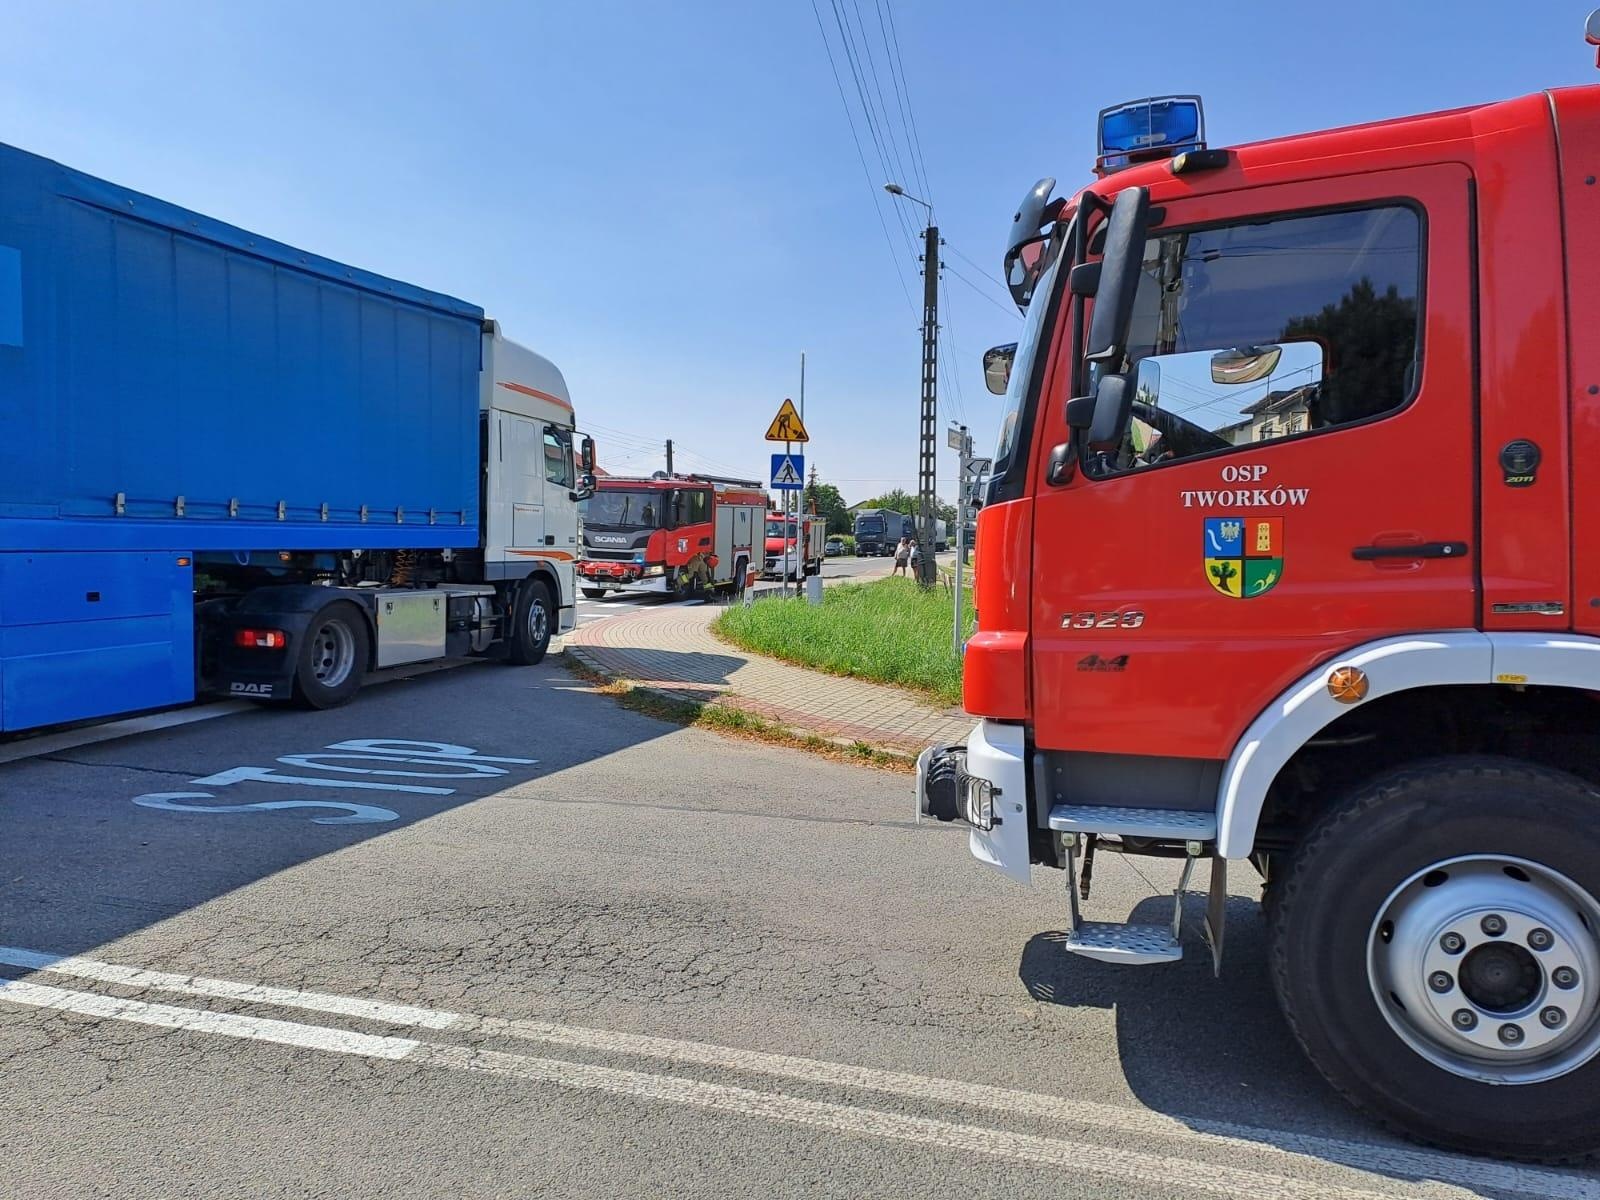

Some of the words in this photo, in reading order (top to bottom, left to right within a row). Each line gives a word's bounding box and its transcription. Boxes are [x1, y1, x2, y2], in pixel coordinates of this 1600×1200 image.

[1221, 465, 1268, 482] OSP
[1180, 484, 1310, 507] TWORKÓW
[594, 535, 627, 544] SCANIA
[1061, 611, 1145, 629] 1329
[230, 682, 273, 693] DAF
[131, 738, 541, 825] STOP
